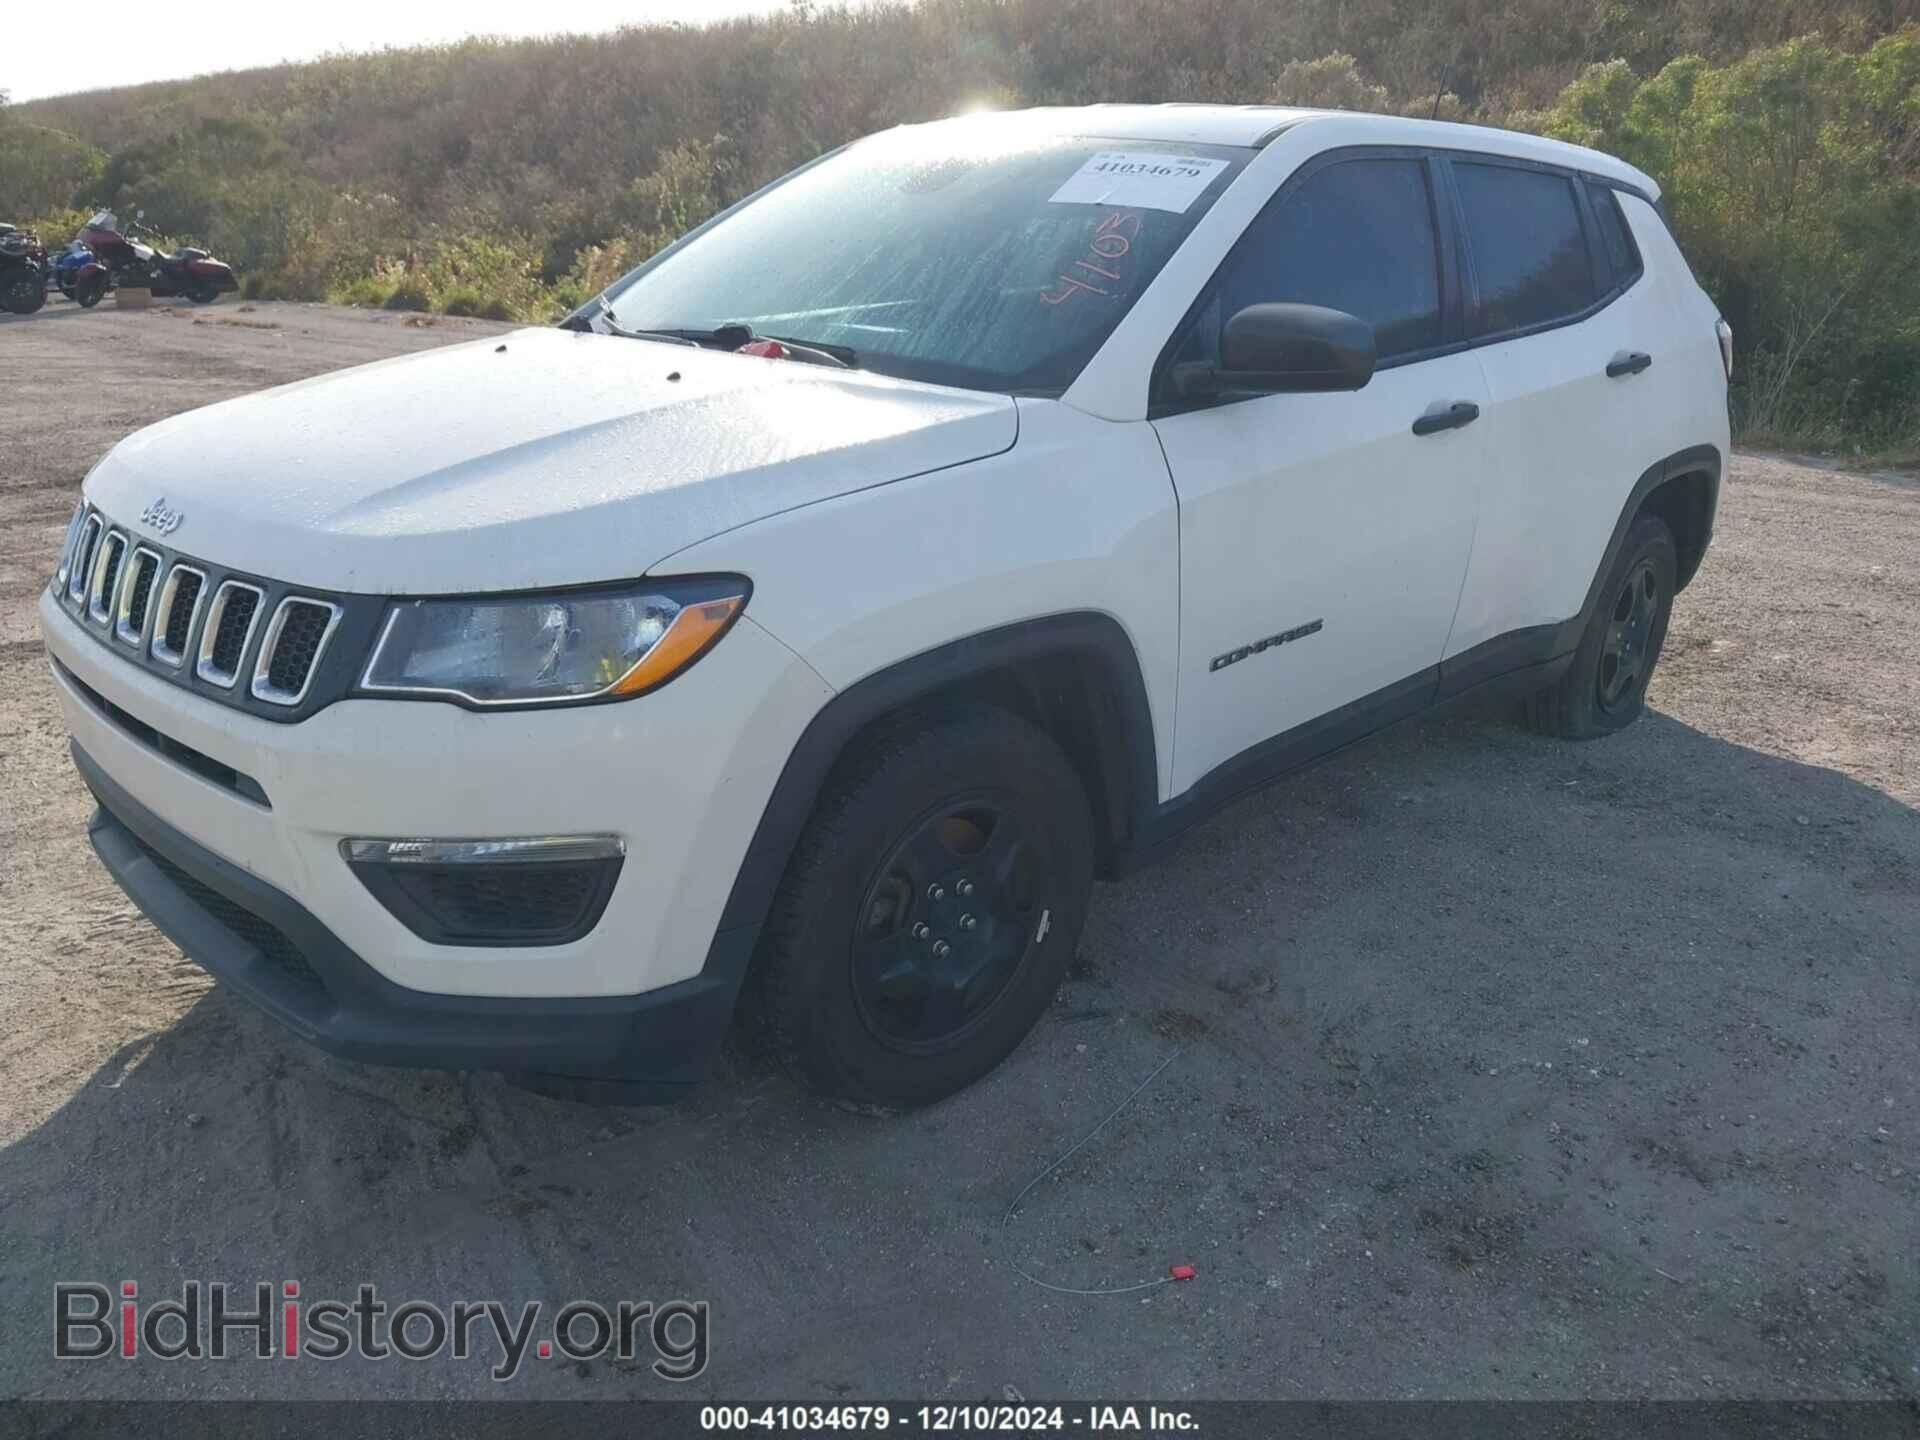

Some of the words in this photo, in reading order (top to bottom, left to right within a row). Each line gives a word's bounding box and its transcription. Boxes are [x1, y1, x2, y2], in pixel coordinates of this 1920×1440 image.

[1093, 161, 1202, 178] 41034679
[140, 497, 184, 537] Jeep
[1208, 618, 1324, 672] COMPASS
